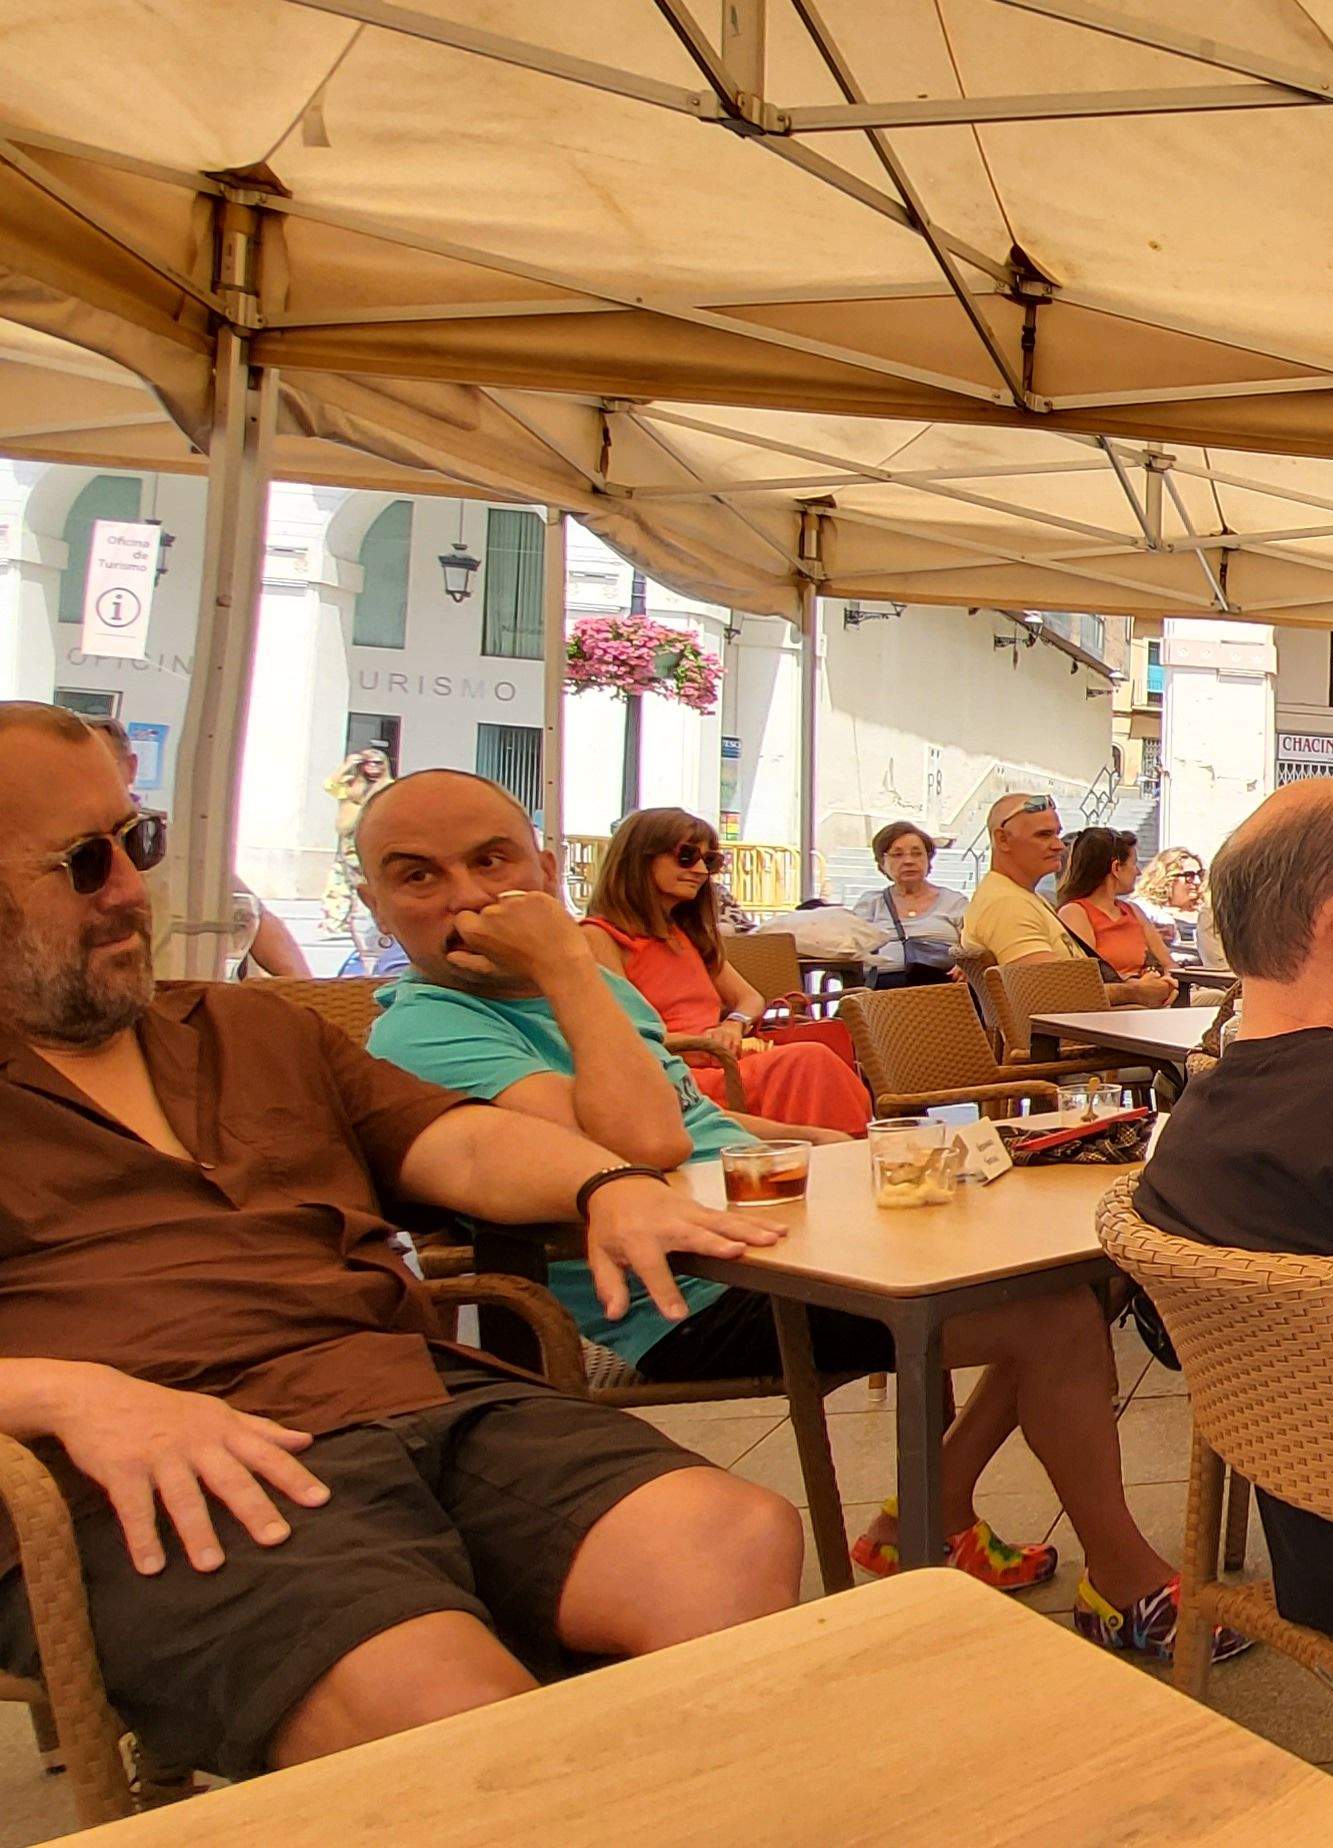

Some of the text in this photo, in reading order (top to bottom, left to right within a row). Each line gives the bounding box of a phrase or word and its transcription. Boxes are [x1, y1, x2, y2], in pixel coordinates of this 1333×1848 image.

[107, 535, 150, 548] Oficina
[132, 551, 149, 560] de
[98, 558, 147, 572] Turismo
